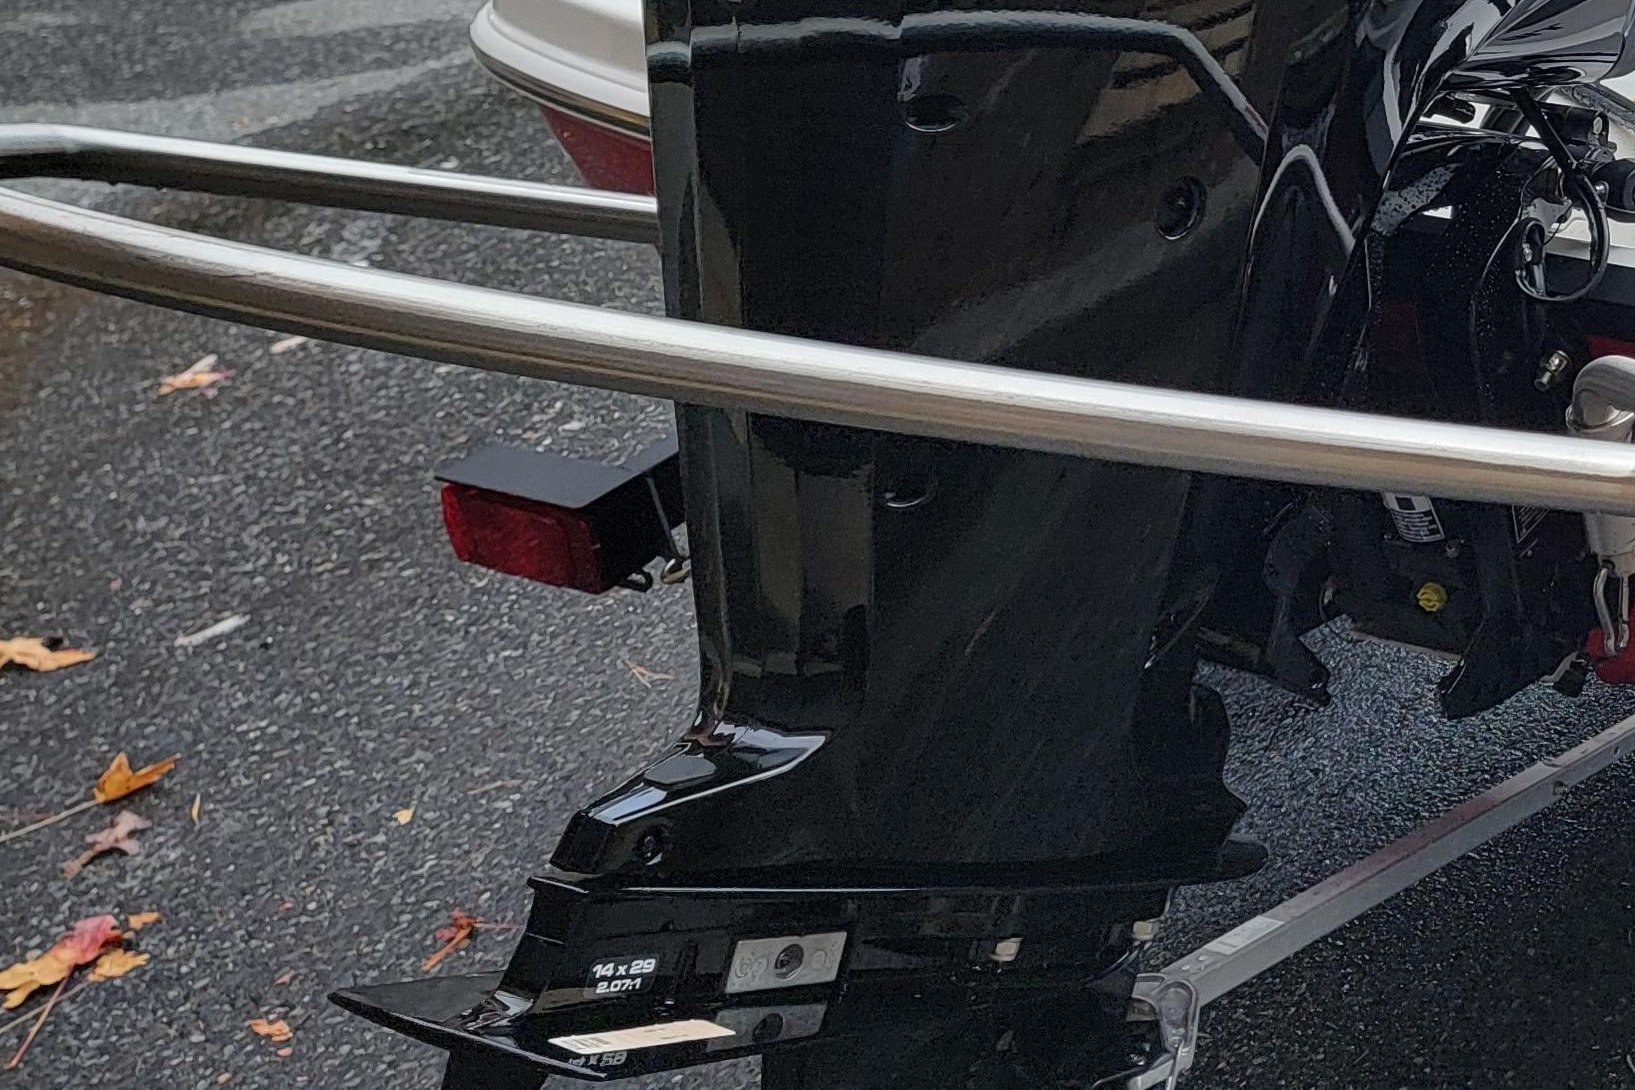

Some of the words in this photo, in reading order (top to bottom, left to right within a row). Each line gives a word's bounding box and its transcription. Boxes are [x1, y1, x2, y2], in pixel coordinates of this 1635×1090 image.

[592, 962, 615, 979] 14
[616, 966, 628, 976] x
[630, 958, 656, 974] 29
[595, 977, 642, 994] 2.07:1
